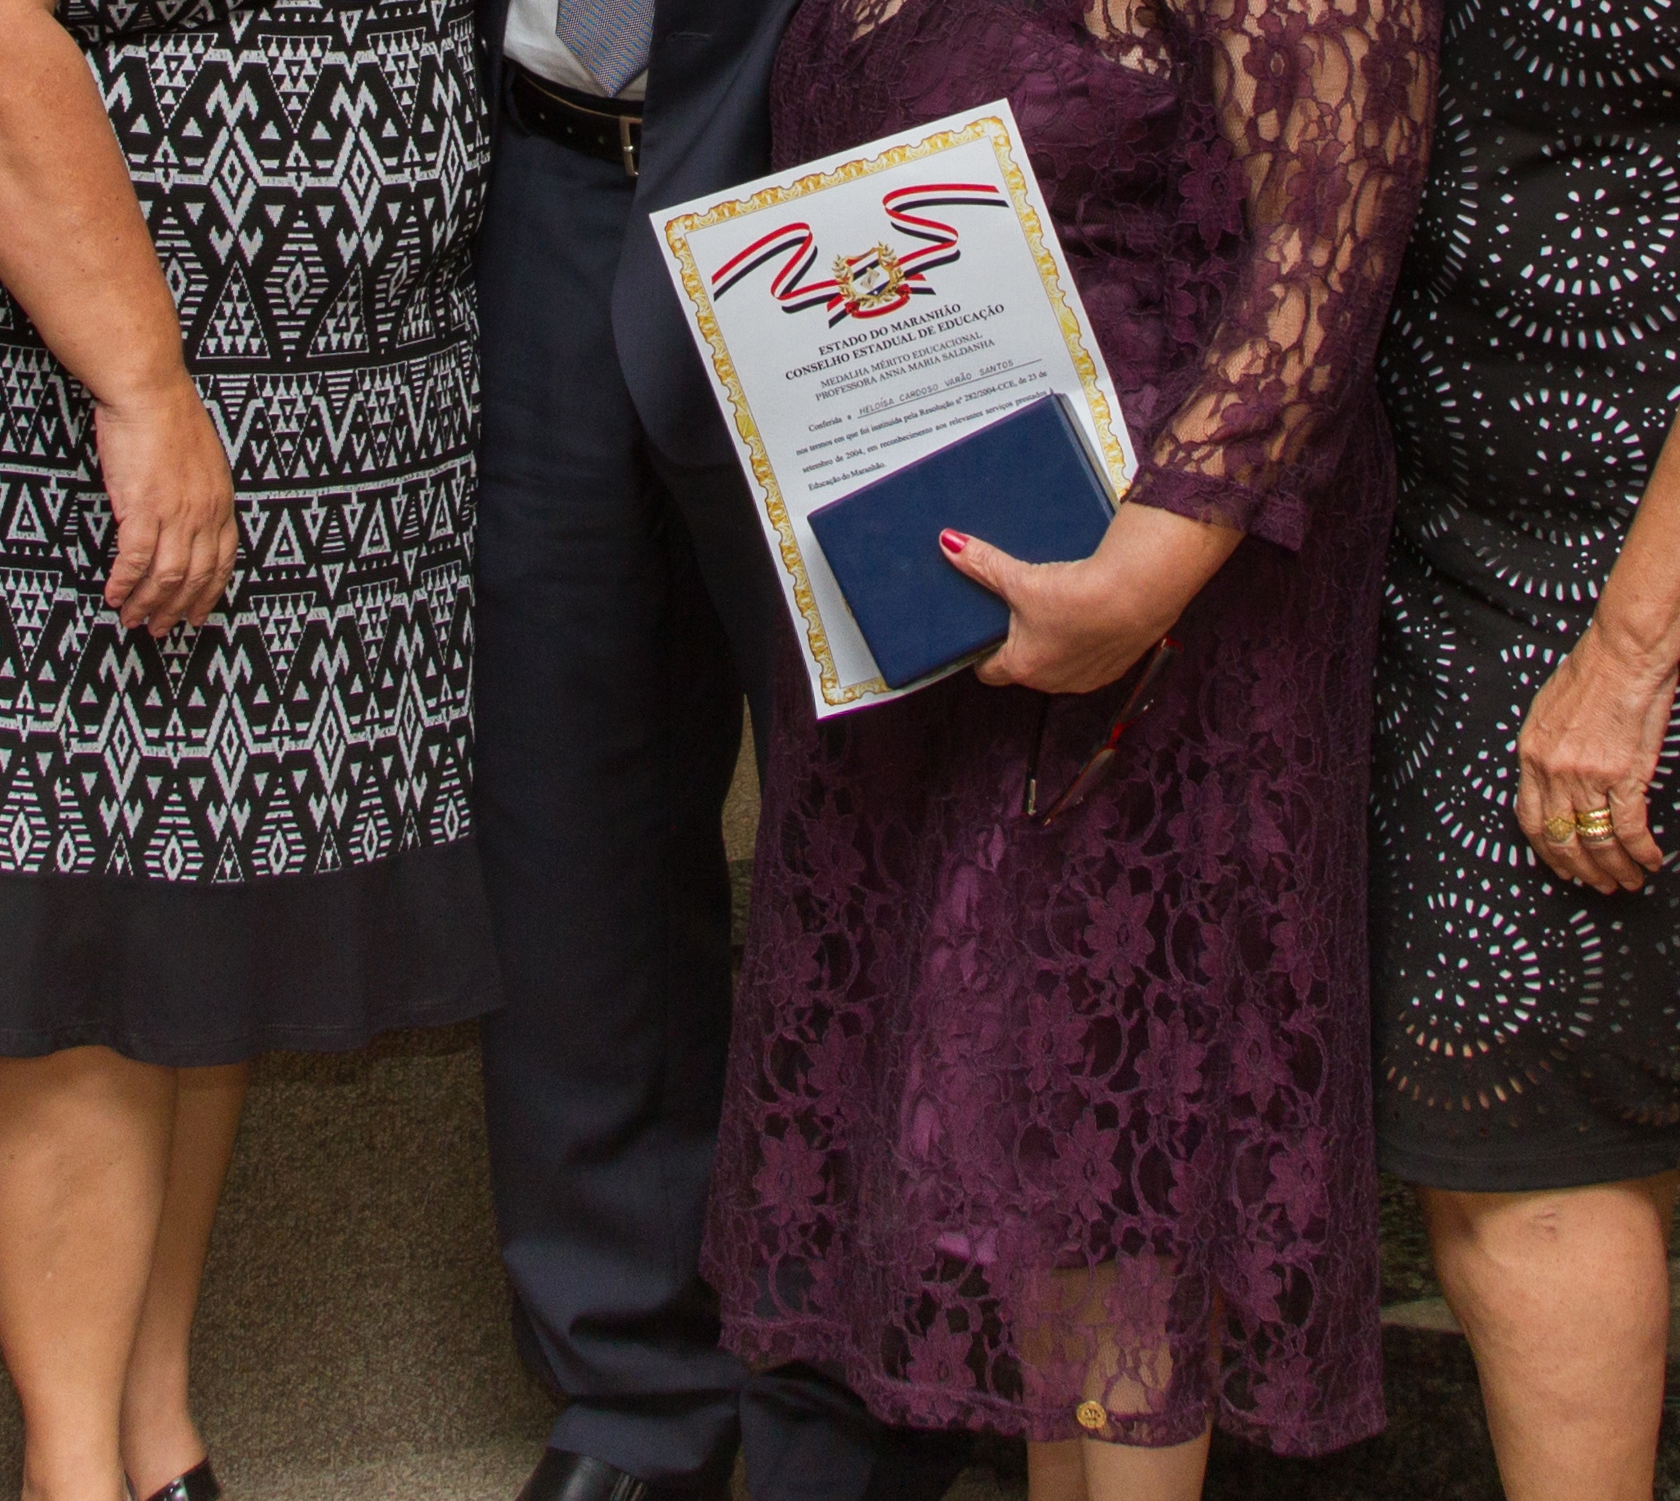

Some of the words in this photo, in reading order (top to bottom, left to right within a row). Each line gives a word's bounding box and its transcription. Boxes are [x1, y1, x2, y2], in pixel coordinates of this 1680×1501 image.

[786, 352, 851, 381] CONSELHO
[853, 332, 917, 360] ESTADUAL
[918, 325, 936, 339] DE
[938, 303, 1005, 333] EDUCAÇÃO
[819, 333, 868, 356] ESTADO
[870, 326, 889, 340] DO
[891, 303, 961, 333] MARANHÃO
[815, 375, 878, 402] PROFESSORA
[880, 366, 907, 382] ANNA
[908, 355, 942, 372] MARIA
[942, 338, 996, 362] SALDANHA
[821, 367, 871, 389] MEDALHA
[871, 353, 911, 373] MÉRITO
[912, 331, 983, 360] EDUCACIONAL
[899, 383, 939, 403] CARDOSO
[944, 371, 973, 387] VARÃO
[979, 359, 1014, 377] SANTOS
